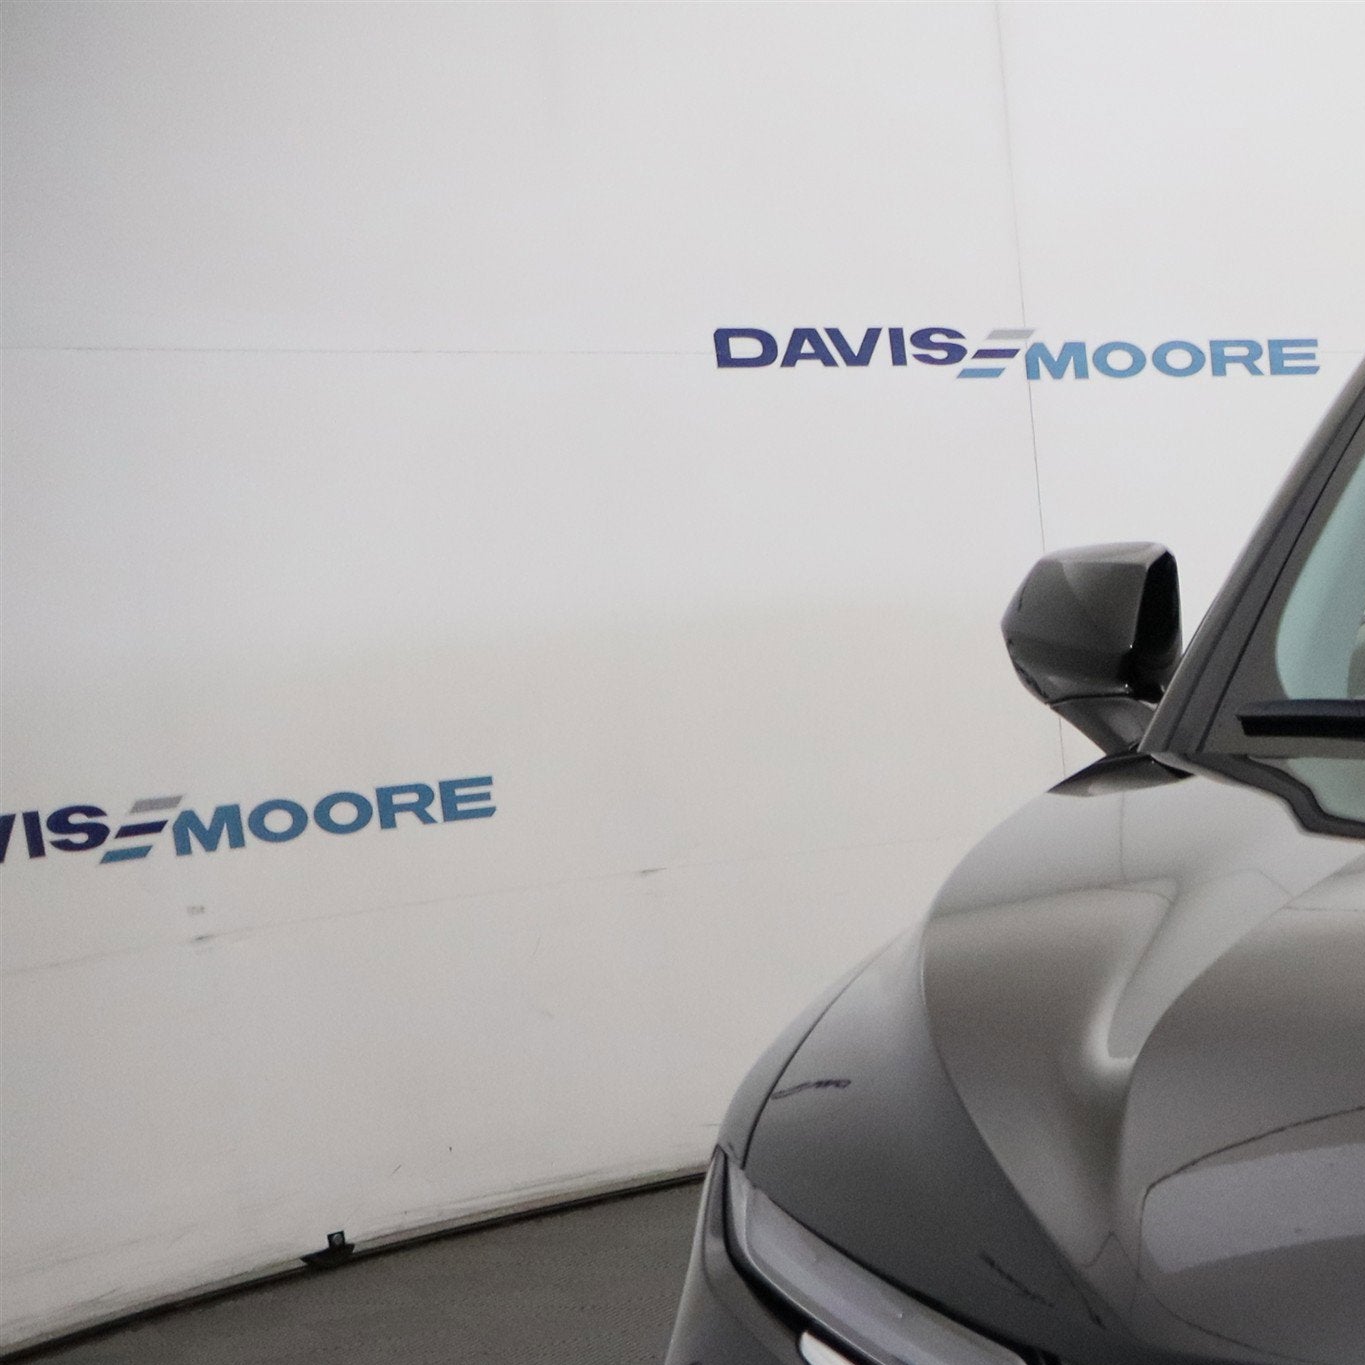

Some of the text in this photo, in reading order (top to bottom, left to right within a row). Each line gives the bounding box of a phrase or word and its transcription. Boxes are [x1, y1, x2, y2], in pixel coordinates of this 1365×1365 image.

[712, 326, 1321, 381] DAVIS MOORE
[171, 775, 497, 858] MOORE
